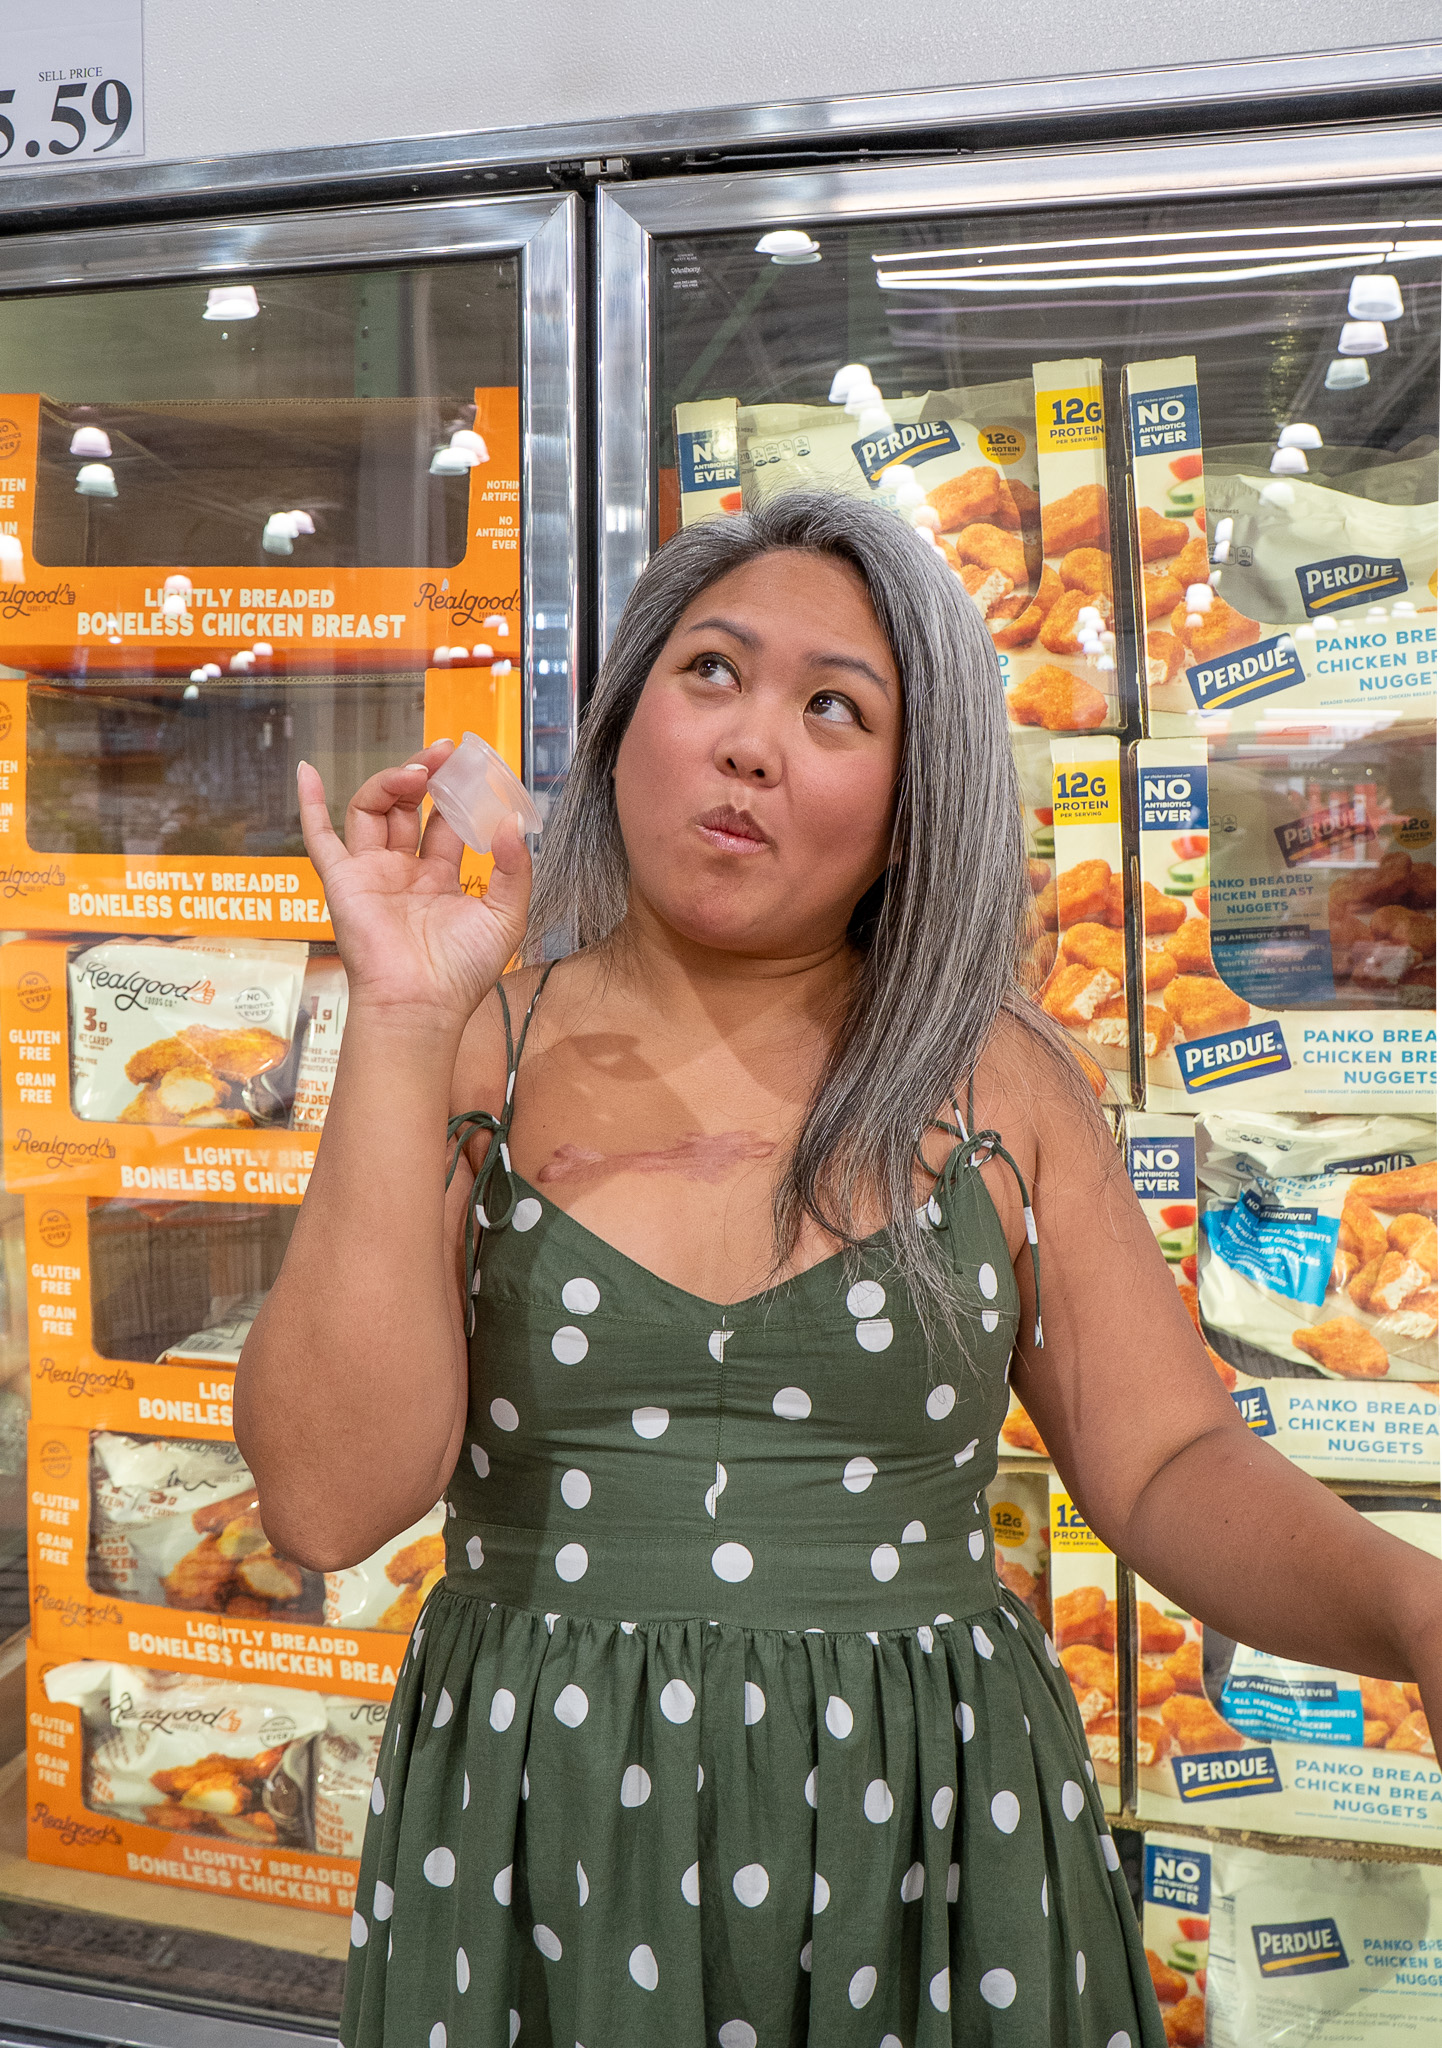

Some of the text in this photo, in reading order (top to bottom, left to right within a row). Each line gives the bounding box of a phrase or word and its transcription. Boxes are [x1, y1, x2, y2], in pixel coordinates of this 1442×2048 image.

[38, 66, 103, 82] SELL PRICE
[1052, 398, 1102, 425] 12G
[1138, 400, 1186, 426] NO
[1050, 424, 1104, 438] PROTEIN
[1139, 422, 1186, 434] ANTIBIOTICS
[861, 421, 946, 468] PERDUE
[985, 433, 1017, 444] 12G
[1140, 430, 1187, 448] EVER
[986, 445, 1020, 453] PROTEIN
[694, 461, 735, 471] ANTIBIOTICS
[694, 470, 736, 484] EVER
[481, 492, 520, 502] ARTIFICI
[499, 516, 512, 525] NO
[476, 528, 520, 537] ANTIBIOT
[492, 540, 516, 550] EVER
[1305, 563, 1393, 594] PERDUE
[240, 588, 335, 608] BREADED
[78, 612, 406, 638] BONELESS CHICKEN BREAST
[1316, 634, 1387, 653] PANKO
[1197, 646, 1287, 696] PERDUE
[1316, 652, 1406, 674] CHICKEN
[1057, 772, 1106, 798] 12G
[1144, 779, 1191, 800] NO
[1054, 800, 1108, 811] PROTEIN
[1075, 810, 1102, 818] SERVING
[1144, 810, 1191, 822] EVER
[1402, 818, 1430, 830] 12G
[126, 871, 300, 893] LIGHTLY BREADED
[1210, 874, 1313, 888] ANKO BREADED
[1210, 886, 1314, 902] HICKEN BREAST
[68, 893, 331, 923] BONELESS CHICKEN BREA
[1226, 902, 1288, 914] NUGGETS
[1228, 932, 1280, 940] ANTIBIOTICS
[26, 978, 38, 986] NO
[77, 962, 201, 1012] Realgood
[26, 995, 46, 1004] EVER
[10, 1030, 60, 1045] GLUTEN
[1304, 1030, 1437, 1043] PANKO BREA
[19, 1046, 51, 1062] FREE
[1185, 1031, 1275, 1073] PERDUE
[1303, 1050, 1392, 1064] CHICKEN
[16, 1072, 56, 1088] GRAIN
[20, 1088, 52, 1104] FREE
[184, 1146, 271, 1168] LIGHTLY
[1133, 1150, 1180, 1170] NO
[121, 1166, 310, 1195] BONELESS CHICK
[1134, 1179, 1180, 1191] EVER
[1246, 1198, 1260, 1211] NO
[32, 1264, 80, 1280] GLUTEN
[41, 1282, 72, 1296] FREE
[38, 1304, 76, 1320] GRAIN
[42, 1322, 74, 1336] FREE
[138, 1398, 233, 1426] BONELES
[1290, 1398, 1438, 1416] PANKO BREAD
[1288, 1417, 1438, 1436] CHICKEN BREA
[1328, 1439, 1424, 1455] NUGGETS
[32, 1491, 80, 1512] GLUTEN
[40, 1510, 70, 1526] FREE
[995, 1512, 1022, 1528] 12G
[36, 1532, 74, 1551] GRAIN
[40, 1550, 70, 1566] FREE
[186, 1621, 359, 1657] LIGHTLY BREADED
[128, 1631, 401, 1686] BONELESS CHICKEN BREA
[1307, 1689, 1332, 1697] EVER
[1233, 1698, 1250, 1706] ALL
[1253, 1698, 1295, 1716] NATURAL
[30, 1712, 74, 1734] GLUTEN
[1236, 1708, 1264, 1717] WHITE
[1266, 1712, 1291, 1724] MEAT
[38, 1730, 66, 1748] FREE
[34, 1752, 70, 1772] GRAIN
[1180, 1756, 1268, 1784] PERDUE
[38, 1768, 66, 1788] FREE
[1295, 1759, 1441, 1784] PANKO BREAD
[1294, 1777, 1441, 1803] CHICKEN BREA
[1334, 1800, 1428, 1820] NUGGETS
[184, 1846, 356, 1888] LIGHTLY BREADED
[1154, 1857, 1200, 1883] NO
[127, 1852, 331, 1905] BONELESS CHICKEN
[1154, 1878, 1200, 1892] ANTIBIOTICS
[1154, 1888, 1198, 1906] EVER
[1258, 1928, 1332, 1956] PERDUE
[1364, 1938, 1413, 1951] PANKO
[1364, 1955, 1428, 1968] CHICKEN
